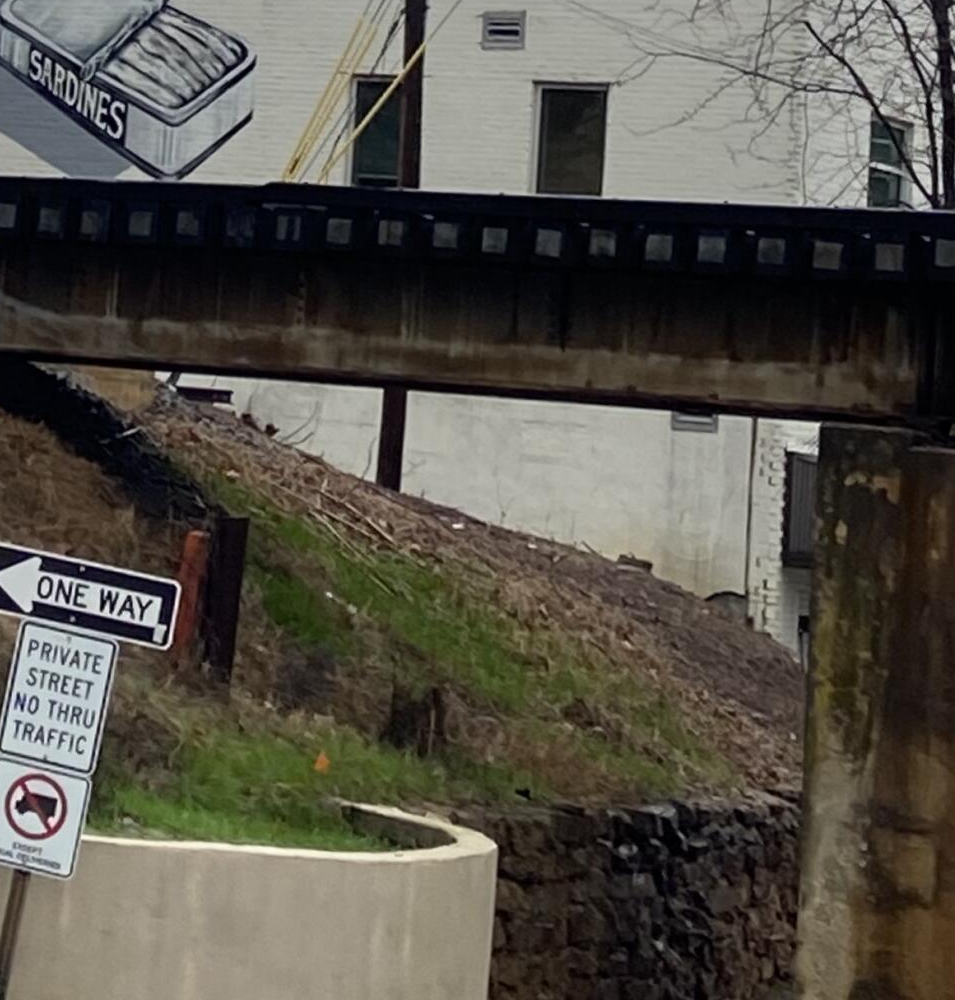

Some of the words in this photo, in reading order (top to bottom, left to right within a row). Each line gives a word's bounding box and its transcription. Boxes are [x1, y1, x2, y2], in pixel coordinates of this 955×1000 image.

[28, 49, 125, 140] SARDINES
[37, 576, 90, 609] ONE
[99, 587, 154, 622] WAY
[28, 638, 105, 675] PRIVATE
[25, 667, 95, 700] STREET
[13, 691, 40, 715] NO
[48, 698, 96, 729] THRU
[13, 719, 87, 755] TRAFFIC
